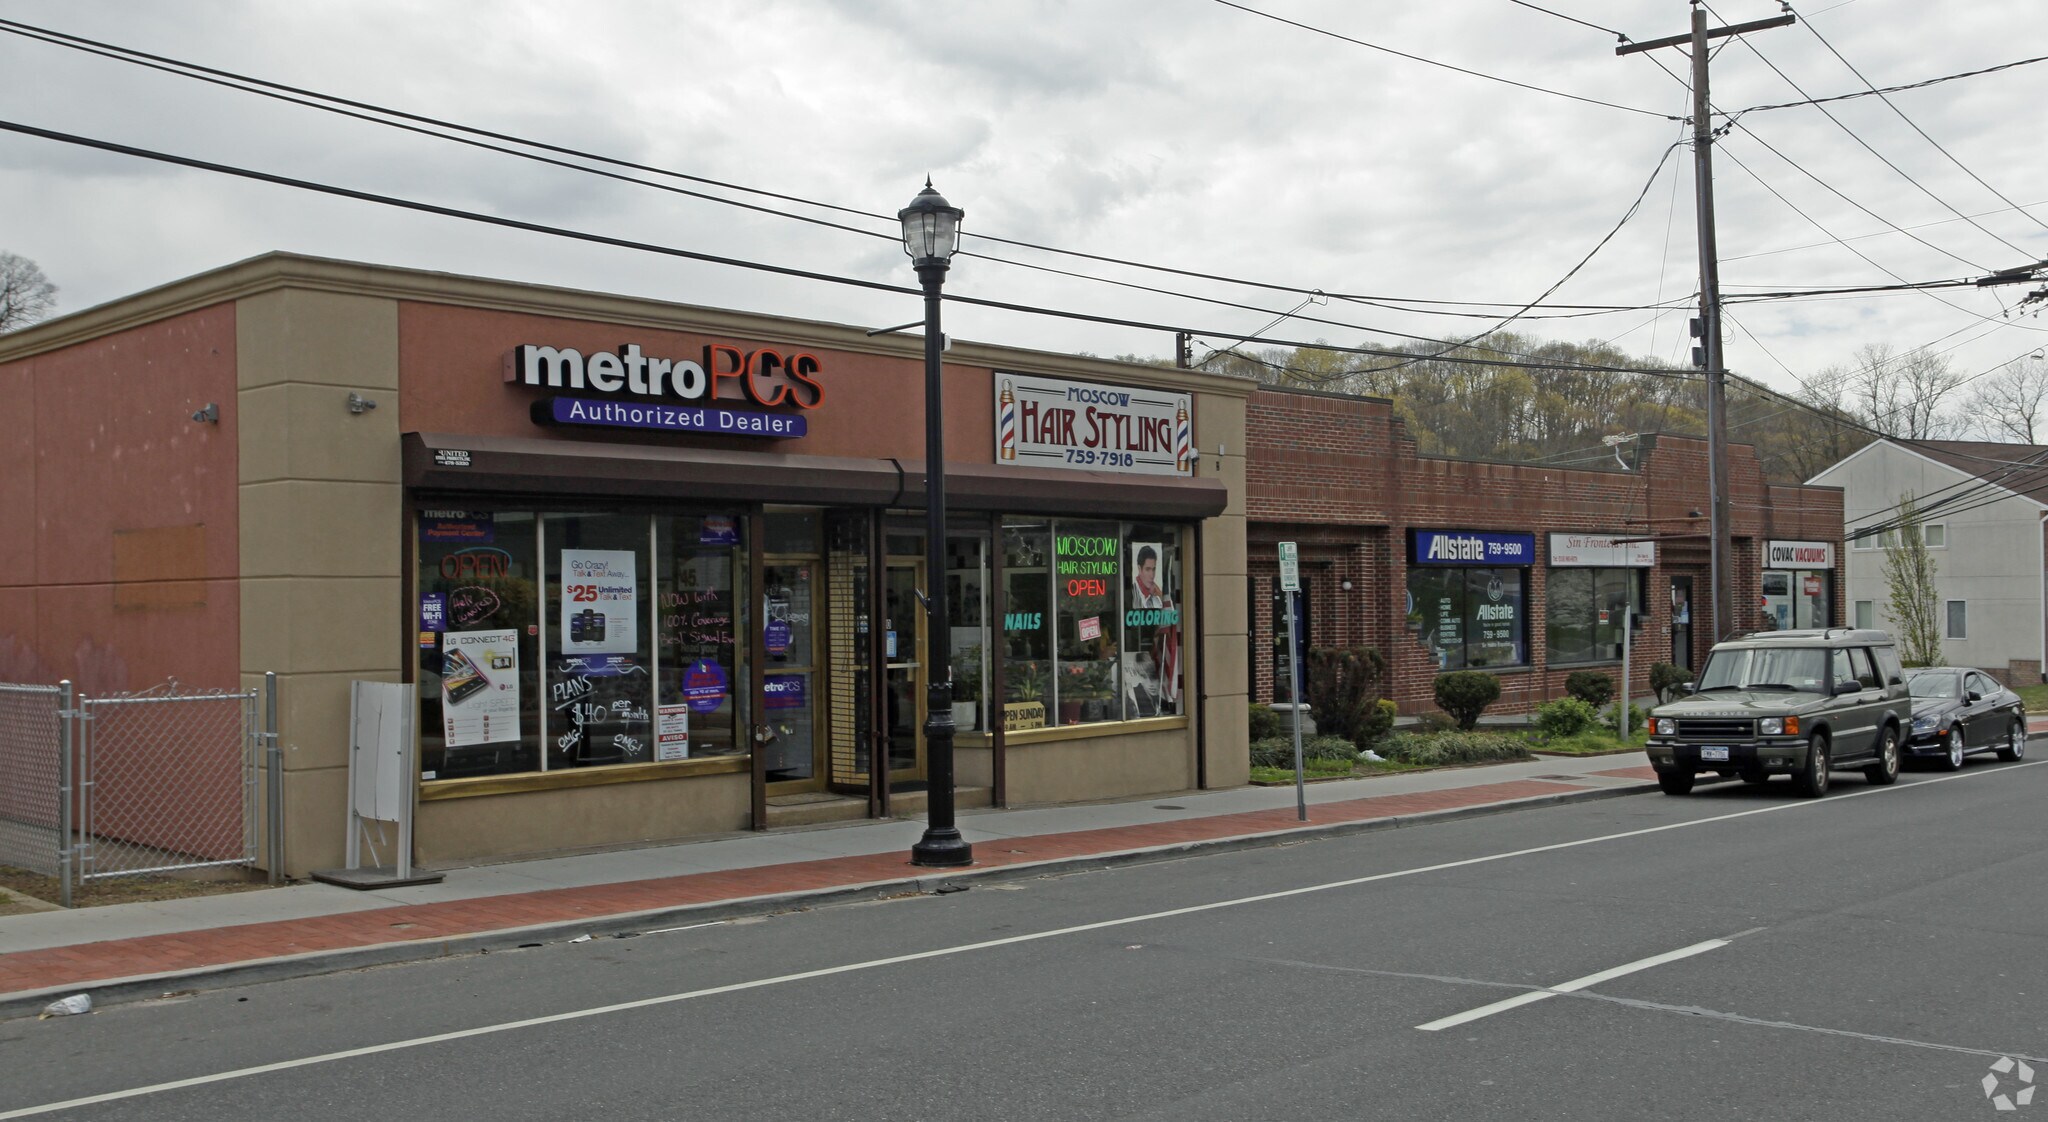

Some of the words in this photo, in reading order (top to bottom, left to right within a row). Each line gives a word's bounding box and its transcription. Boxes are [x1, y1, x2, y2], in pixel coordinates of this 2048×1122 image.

[523, 343, 826, 410] metroPCS
[1067, 387, 1131, 407] MOSCOW
[569, 400, 705, 427] Authorized
[719, 411, 794, 433] Dealer
[1020, 400, 1078, 447] HAIR
[1083, 406, 1172, 454] STYLING
[1057, 536, 1117, 556] MOSCOW
[1428, 535, 1485, 560] Allstate
[1488, 542, 1522, 555] 759-9500
[1566, 536, 1582, 549] Sin
[1772, 547, 1794, 562] COVAC
[1795, 547, 1826, 563] VACUUMS
[441, 554, 509, 579] OPEN
[571, 560, 584, 569] Go
[585, 560, 609, 571] Crazy!
[1057, 561, 1078, 574] HAIR
[1079, 561, 1118, 574] STYLING
[567, 584, 598, 602] $25
[694, 586, 718, 603] with
[1068, 579, 1106, 597] OPEN
[423, 604, 442, 612] FREE
[423, 612, 442, 620] WI-FI
[1476, 604, 1514, 620] Allstate
[1004, 612, 1042, 631] NAILS
[1126, 609, 1180, 627] COLORING
[460, 635, 502, 645] CONNECT
[502, 634, 516, 643] 4G
[1081, 625, 1099, 639] OPEN
[553, 674, 593, 701] PLANS
[764, 681, 800, 692] etroPCS
[572, 703, 607, 725] $40
[612, 699, 631, 710] per
[622, 707, 649, 720] month
[1019, 707, 1045, 720] SUNDAY
[614, 733, 644, 755] OMG!
